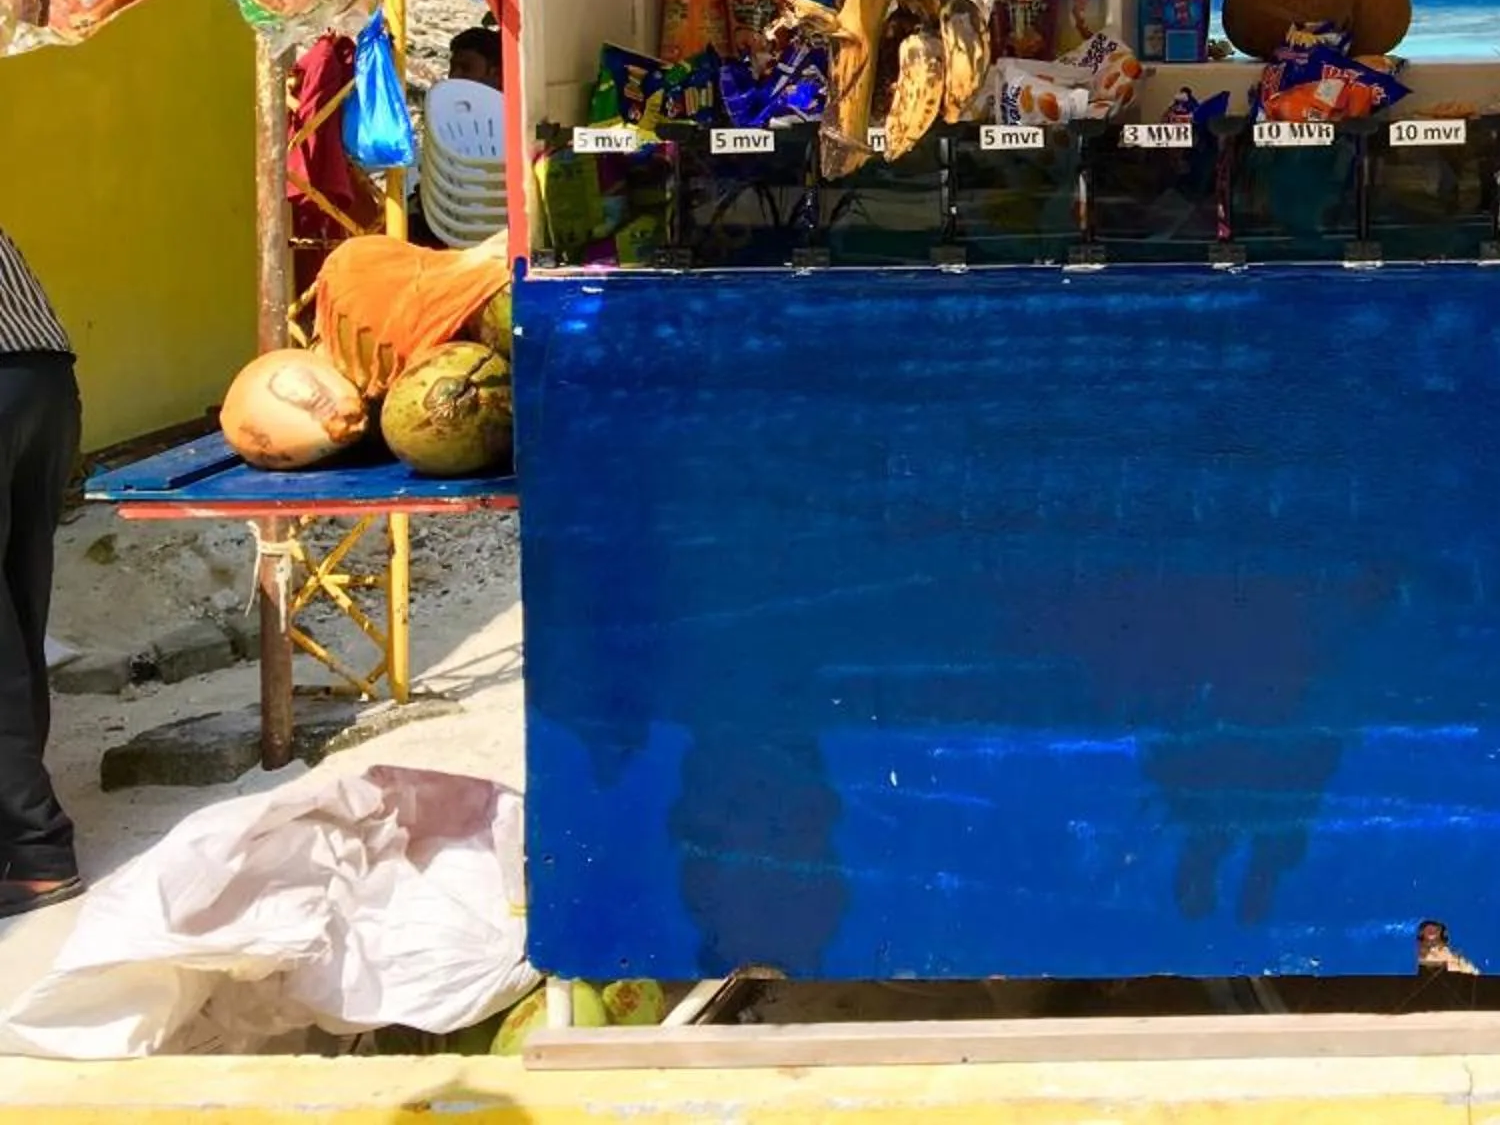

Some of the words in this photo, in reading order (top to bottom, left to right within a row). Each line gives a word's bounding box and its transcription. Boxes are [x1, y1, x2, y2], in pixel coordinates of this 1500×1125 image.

[579, 132, 588, 148] 5
[595, 135, 632, 148] mvr
[716, 132, 726, 148] 5
[733, 134, 770, 148] mvr
[984, 129, 995, 145] 5
[1001, 130, 1038, 145] mvr
[1147, 126, 1189, 142] MVR
[1256, 124, 1281, 140] 10
[1395, 124, 1418, 141] 10
[1423, 126, 1461, 141] mvr
